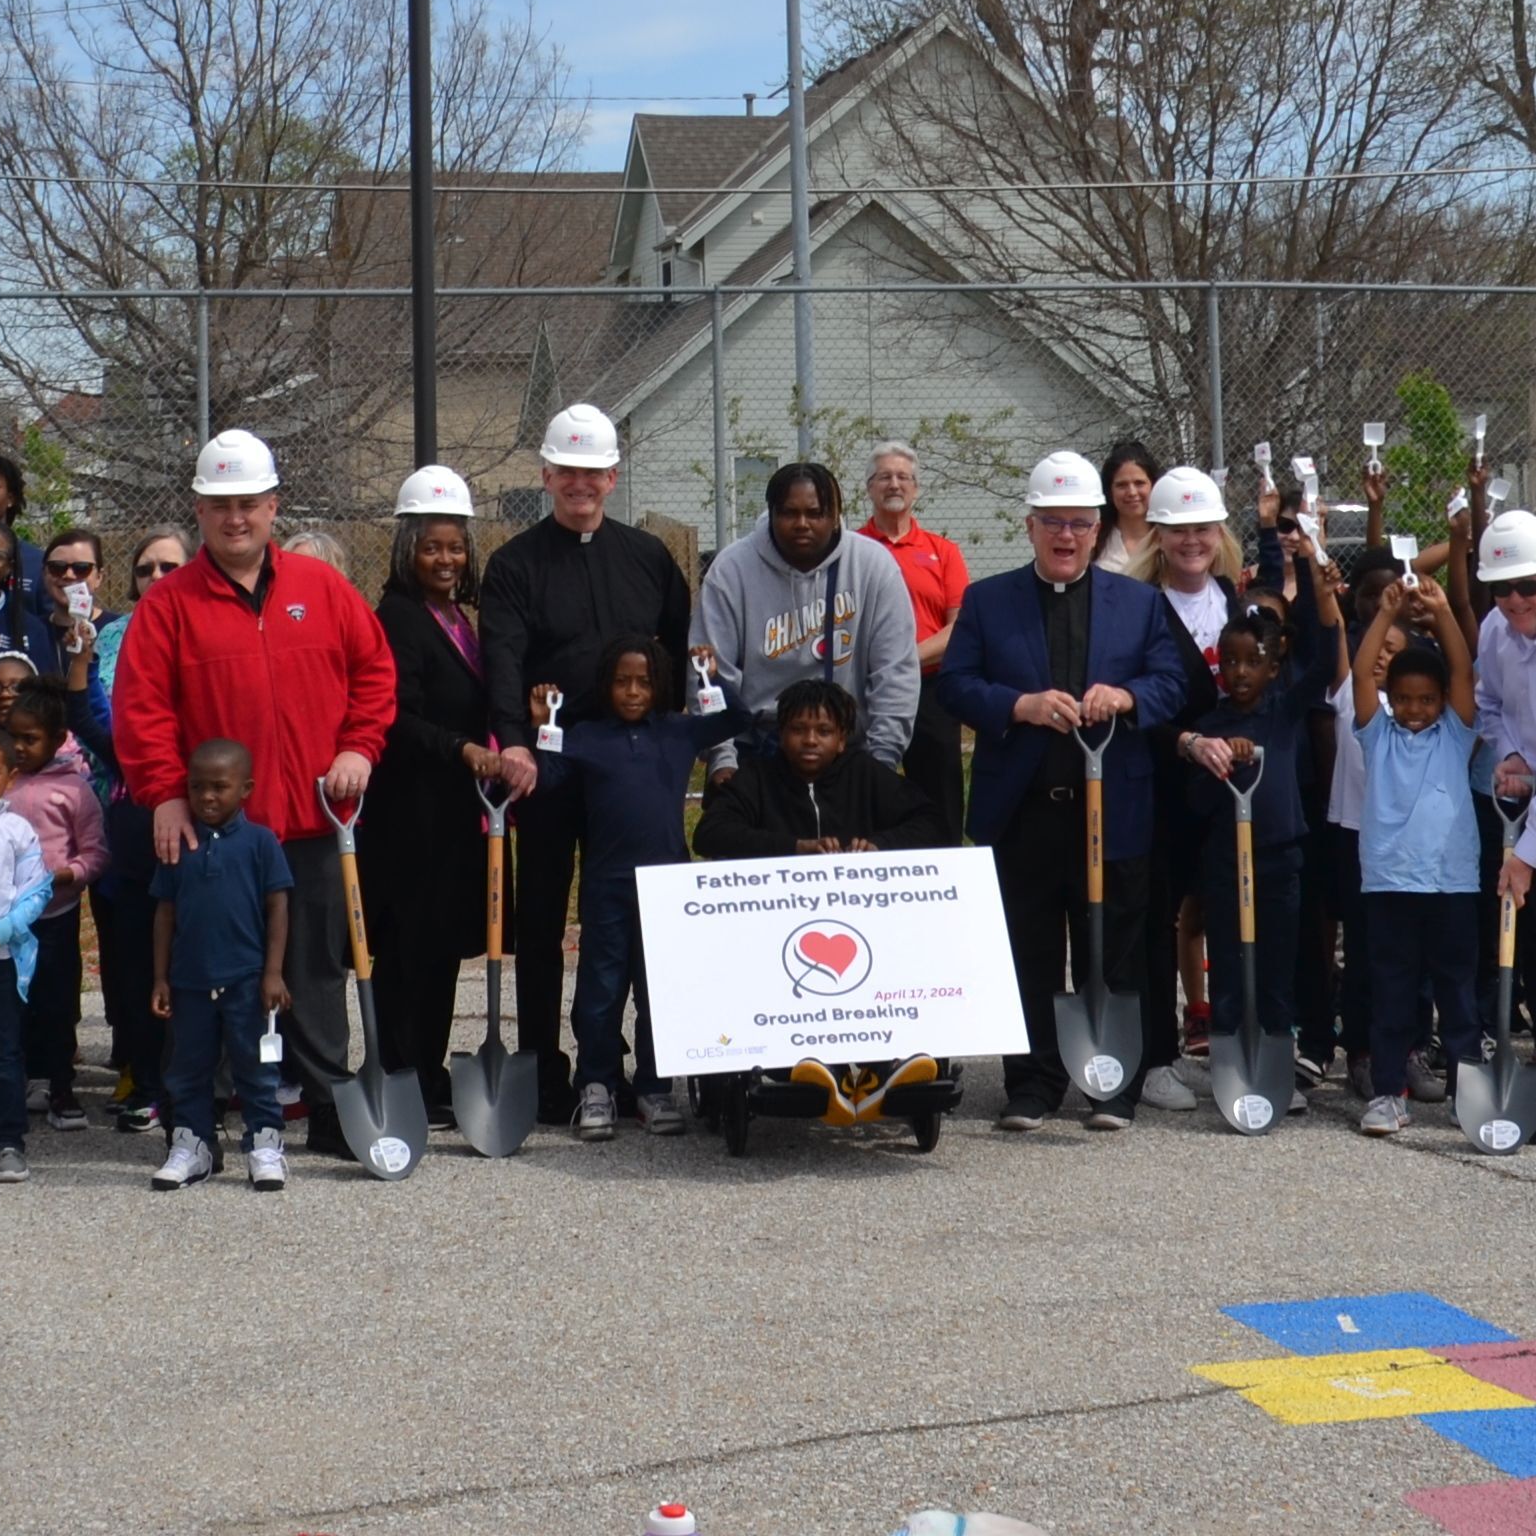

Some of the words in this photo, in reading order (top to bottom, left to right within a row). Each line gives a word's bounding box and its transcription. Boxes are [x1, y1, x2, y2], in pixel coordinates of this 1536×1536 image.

[764, 592, 856, 660] CHAMPON
[696, 871, 771, 890] Father
[776, 868, 828, 884] Tom
[834, 864, 939, 882] Fangman
[684, 893, 820, 916] Community
[827, 886, 958, 908] Playground
[874, 989, 906, 1002] April
[910, 989, 927, 1000] 17,
[930, 987, 963, 999] 2024
[753, 1008, 827, 1026] Ground
[832, 1004, 919, 1021] Breaking
[790, 1030, 893, 1046] Ceremony
[686, 1046, 724, 1059] CUES
